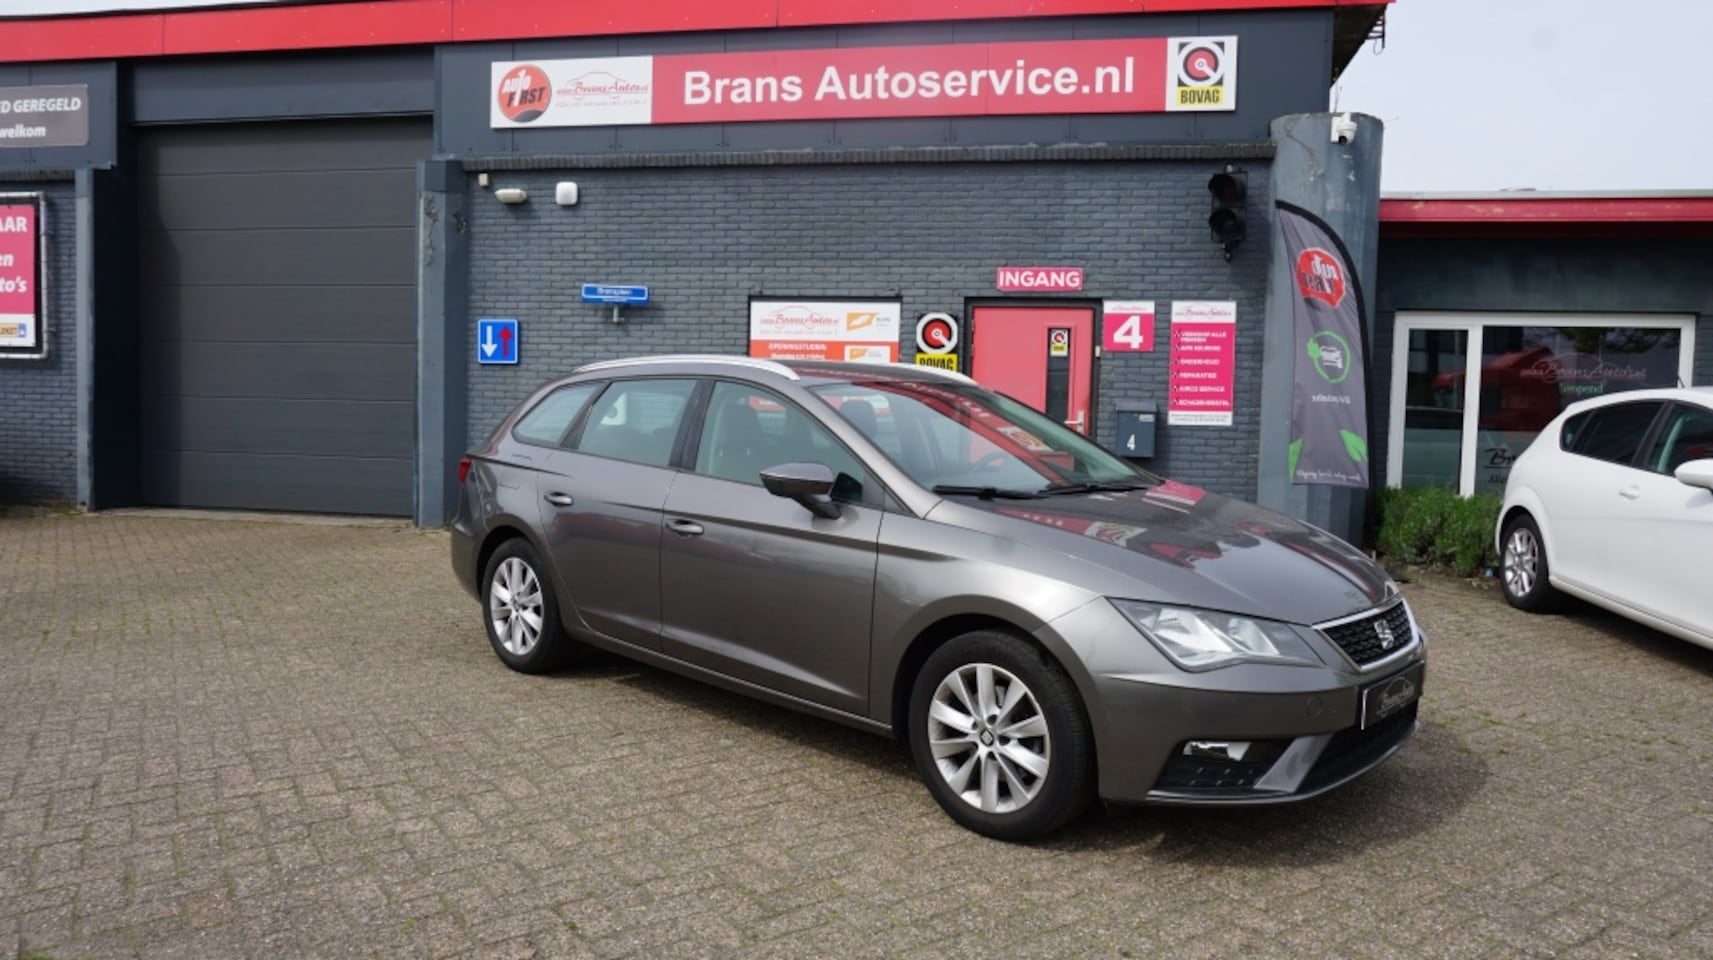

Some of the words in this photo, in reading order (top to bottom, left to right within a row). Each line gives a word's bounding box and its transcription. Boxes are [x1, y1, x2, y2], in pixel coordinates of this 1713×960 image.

[684, 70, 803, 105] Brans
[814, 56, 1134, 101] Autoservice.nl
[12, 96, 82, 113] GEREGELD
[1180, 88, 1220, 104] BOVAG
[999, 271, 1081, 288] INGANG
[1113, 315, 1143, 349] 4
[1127, 433, 1136, 451] 4
